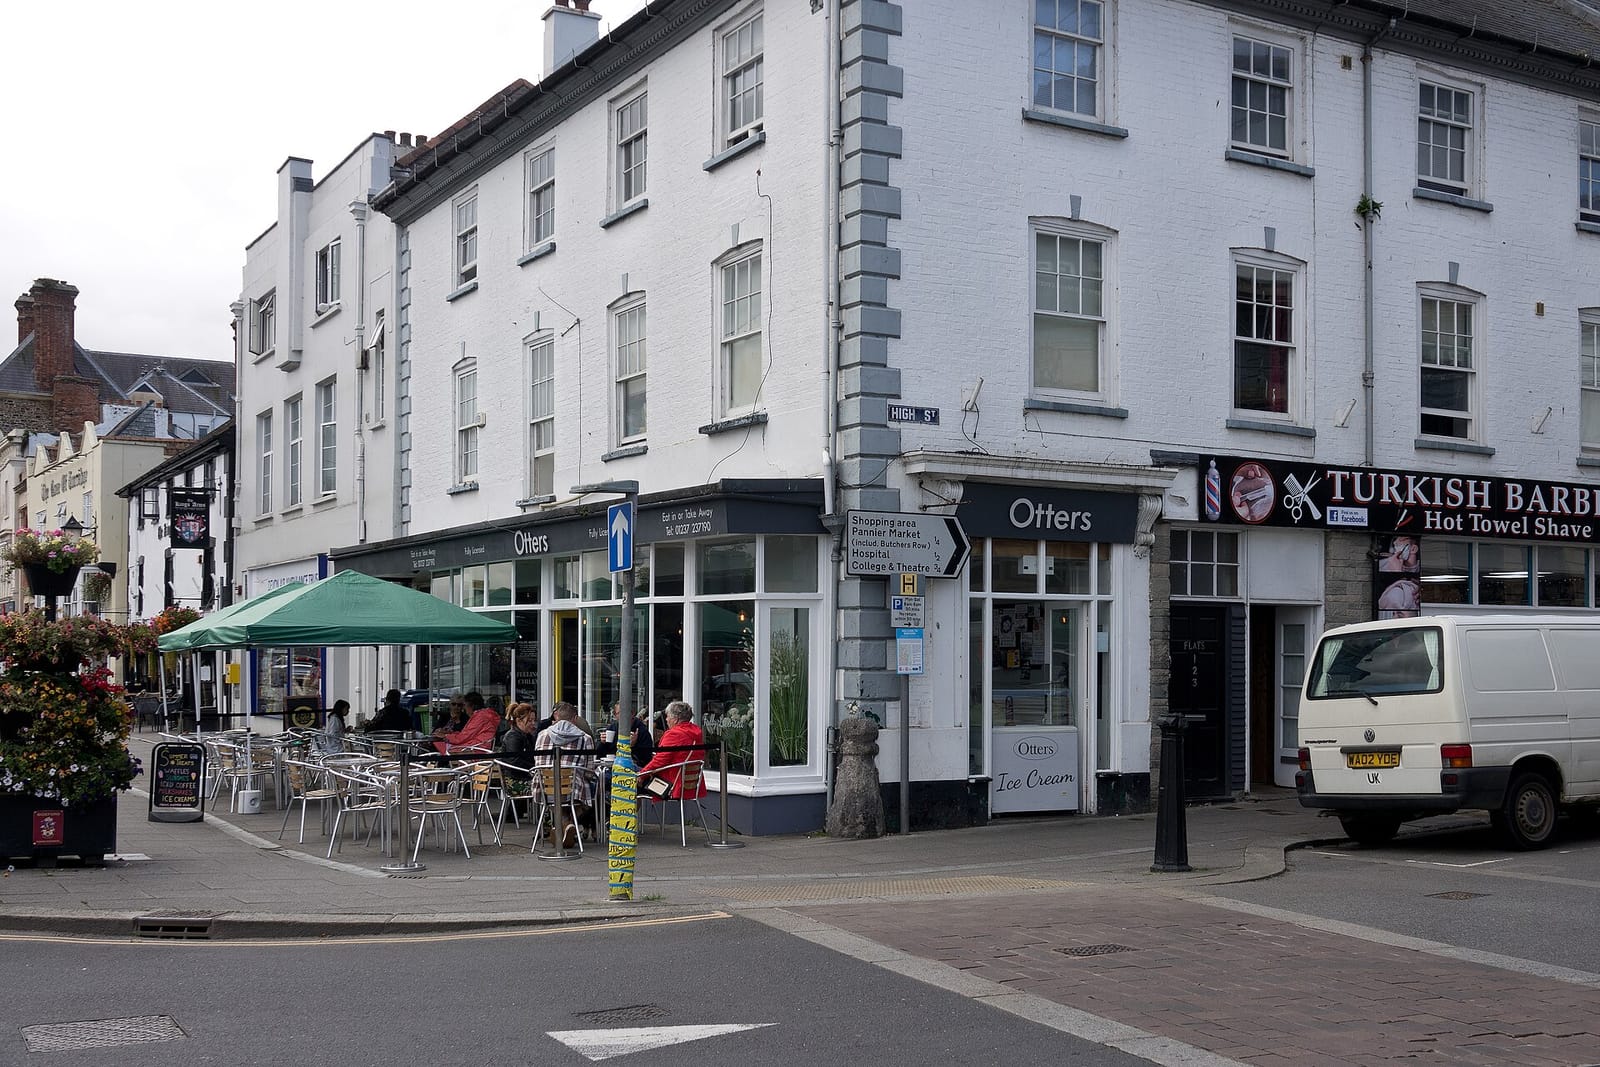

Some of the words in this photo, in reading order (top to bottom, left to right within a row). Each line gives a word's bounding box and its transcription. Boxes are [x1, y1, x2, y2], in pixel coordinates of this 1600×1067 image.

[891, 407, 916, 421] HIGH
[1326, 470, 1492, 510] TURKISH
[662, 511, 670, 522] Eat
[671, 511, 677, 521] in
[685, 508, 697, 519] Take
[698, 507, 713, 519] Away
[1009, 498, 1092, 531] Otters
[852, 515, 895, 528] Shopping
[896, 520, 917, 528] area
[1424, 510, 1463, 531] Hot
[1468, 513, 1529, 534] Towel
[1534, 516, 1592, 538] Shave
[588, 527, 598, 539] Fully
[852, 527, 887, 537] Pannier
[889, 528, 921, 539] Market
[514, 530, 549, 555] Otters
[880, 539, 911, 549] Butchers
[912, 541, 931, 550] Row)
[852, 548, 890, 559] Hospital
[852, 561, 887, 572] College
[888, 562, 895, 571] &
[896, 562, 931, 573] Theatre
[902, 575, 915, 593] H
[894, 599, 901, 609] P
[1183, 640, 1206, 650] FLATS
[1192, 665, 1198, 675] 2
[1192, 678, 1198, 687] 3
[1018, 741, 1054, 756] Otters
[1348, 753, 1374, 766] WA02
[996, 772, 1022, 792] Ice
[1026, 768, 1075, 789] Cream
[1367, 772, 1381, 784] UK
